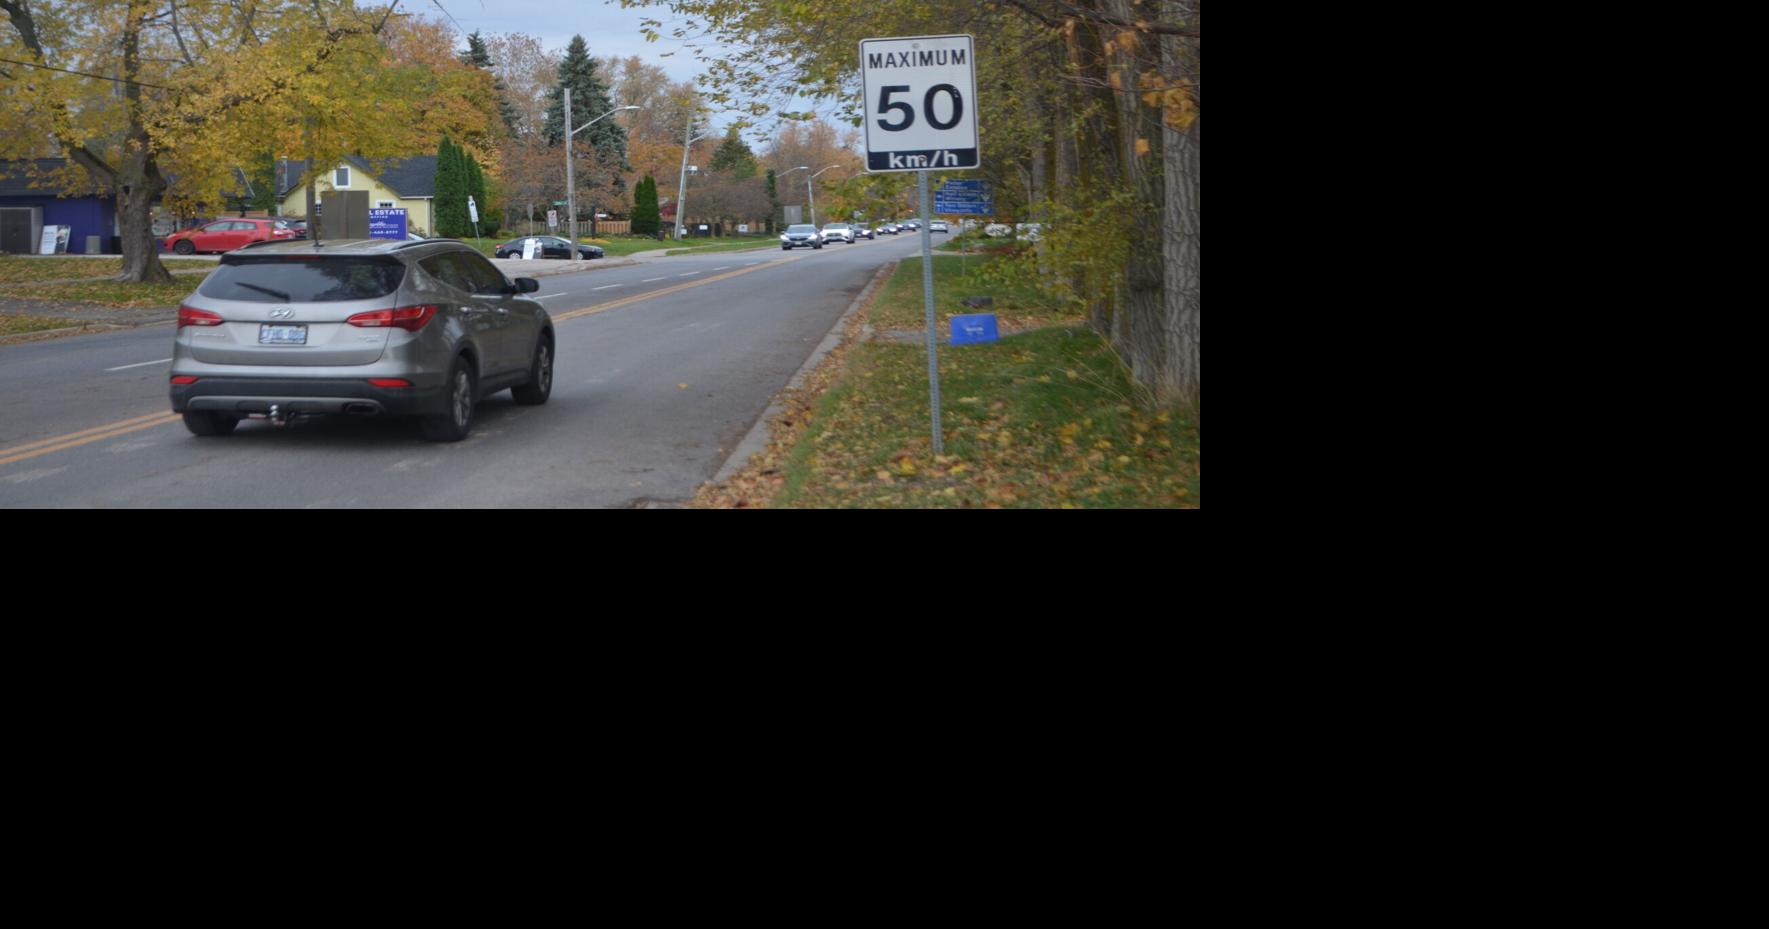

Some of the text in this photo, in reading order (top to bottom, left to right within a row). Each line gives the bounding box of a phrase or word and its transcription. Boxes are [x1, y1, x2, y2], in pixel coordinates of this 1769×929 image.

[868, 49, 966, 69] MAXIMUM
[876, 83, 964, 132] 50
[888, 150, 959, 169] km/h
